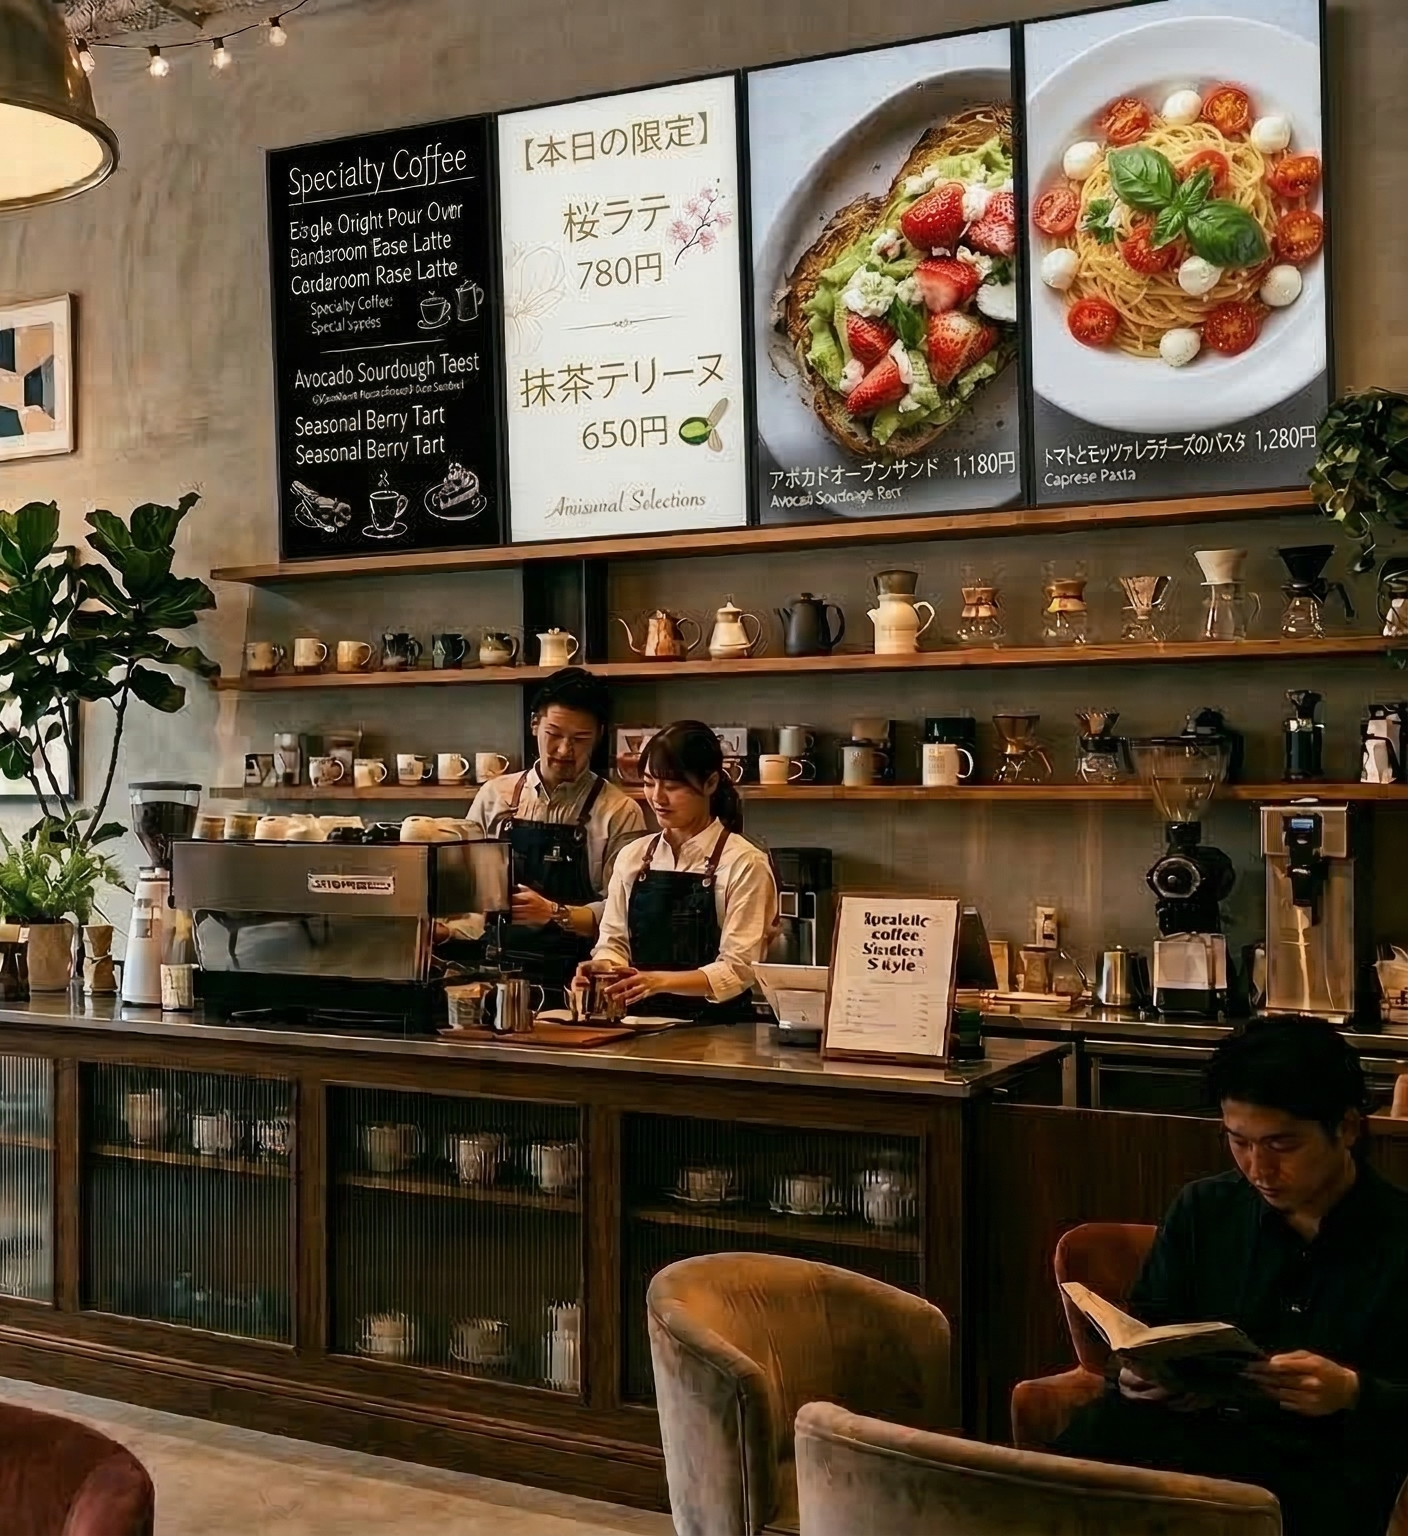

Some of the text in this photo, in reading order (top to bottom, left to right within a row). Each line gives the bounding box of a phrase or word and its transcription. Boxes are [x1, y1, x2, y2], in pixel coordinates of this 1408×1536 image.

[524, 111, 708, 171] 【本日の限定】
[288, 142, 467, 203] Specialty Coffee
[388, 208, 423, 228] Pour
[563, 194, 671, 243] 桜ラテ
[413, 231, 452, 253] Latte
[376, 265, 412, 286] Rase
[417, 258, 458, 281] Latte
[577, 252, 662, 290] 780円
[294, 352, 480, 390] Avocado Sourdough Taest
[520, 353, 724, 408] 抹茶テリーヌ
[295, 404, 446, 437] Seasonal Berry Tart
[582, 415, 668, 450] 650円
[295, 435, 446, 466] Seasonal Berry Tart
[1255, 425, 1317, 453] 1,280円
[953, 451, 1016, 478] 1,180円
[1044, 472, 1097, 489] Caprese
